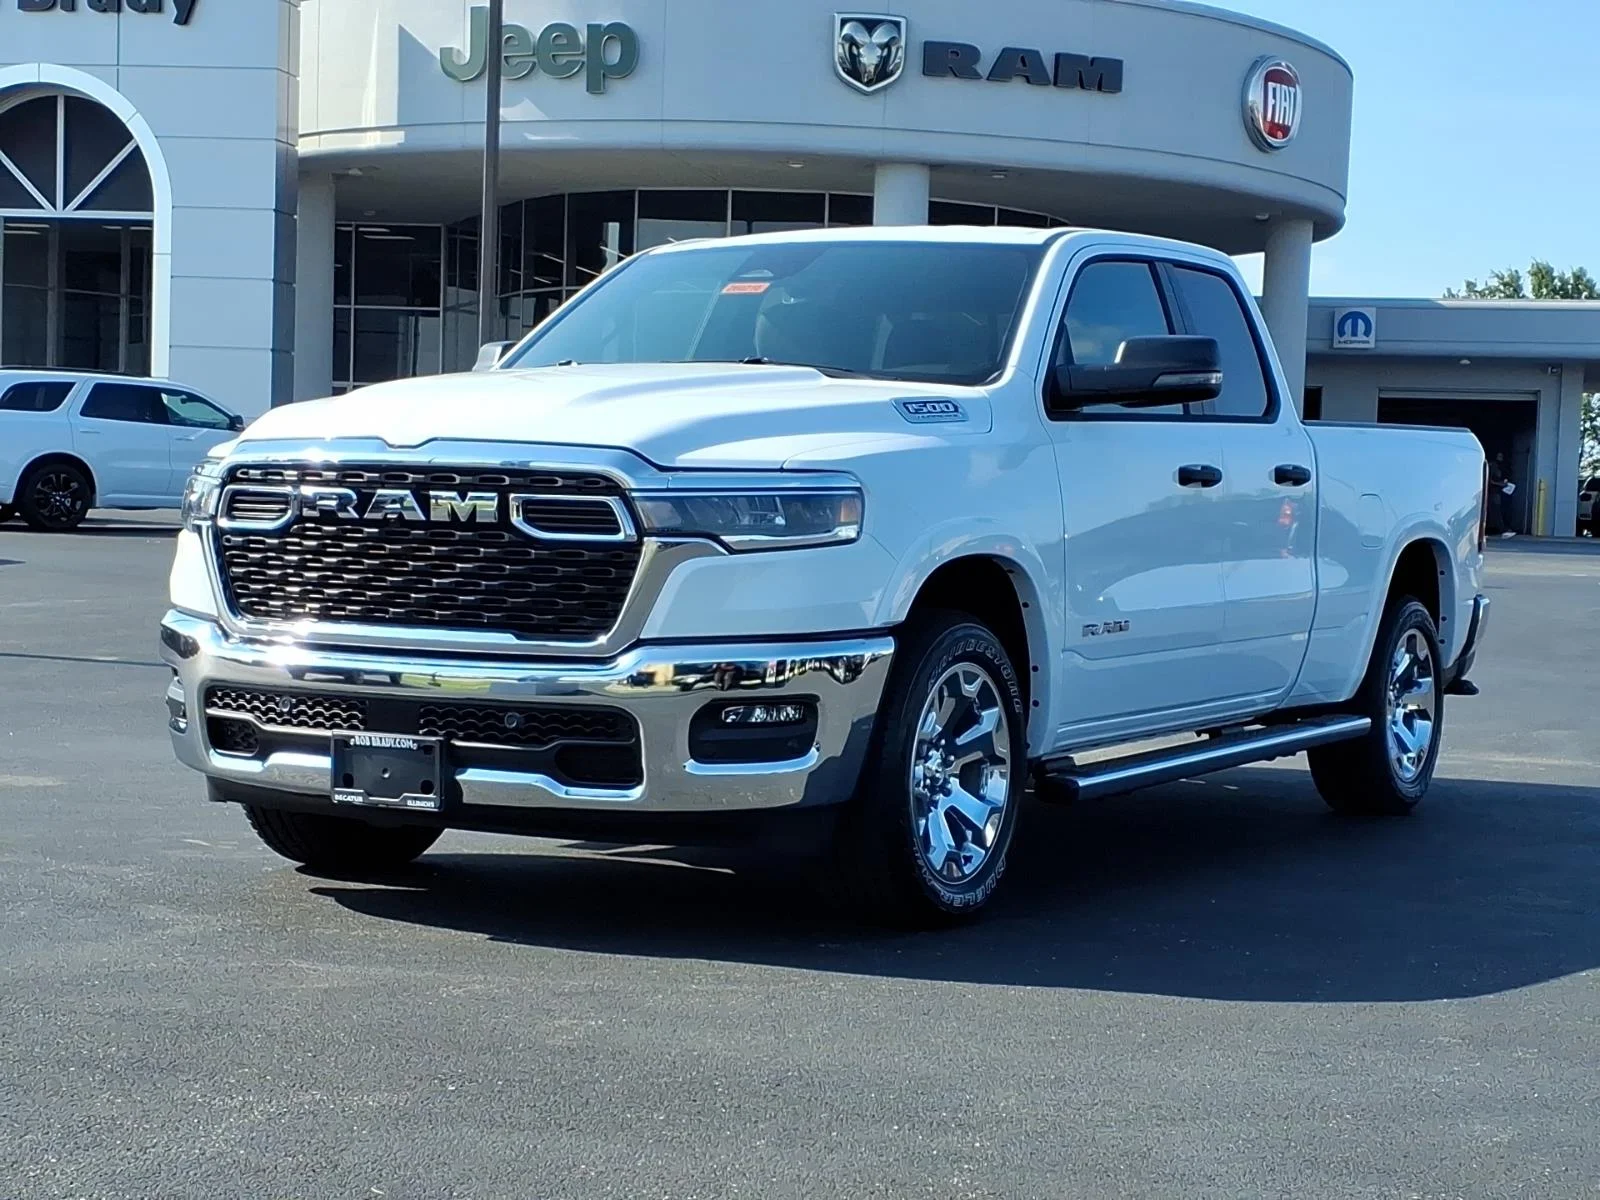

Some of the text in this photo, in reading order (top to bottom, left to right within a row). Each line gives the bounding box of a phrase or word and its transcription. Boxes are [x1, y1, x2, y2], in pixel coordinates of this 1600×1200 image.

[440, 6, 639, 94] Jeep
[922, 40, 1124, 93] RAM
[1267, 81, 1296, 126] FIAT
[905, 402, 955, 413] 1500
[300, 485, 498, 522] RAM
[1082, 620, 1130, 637] RAM
[354, 735, 371, 746] BOB
